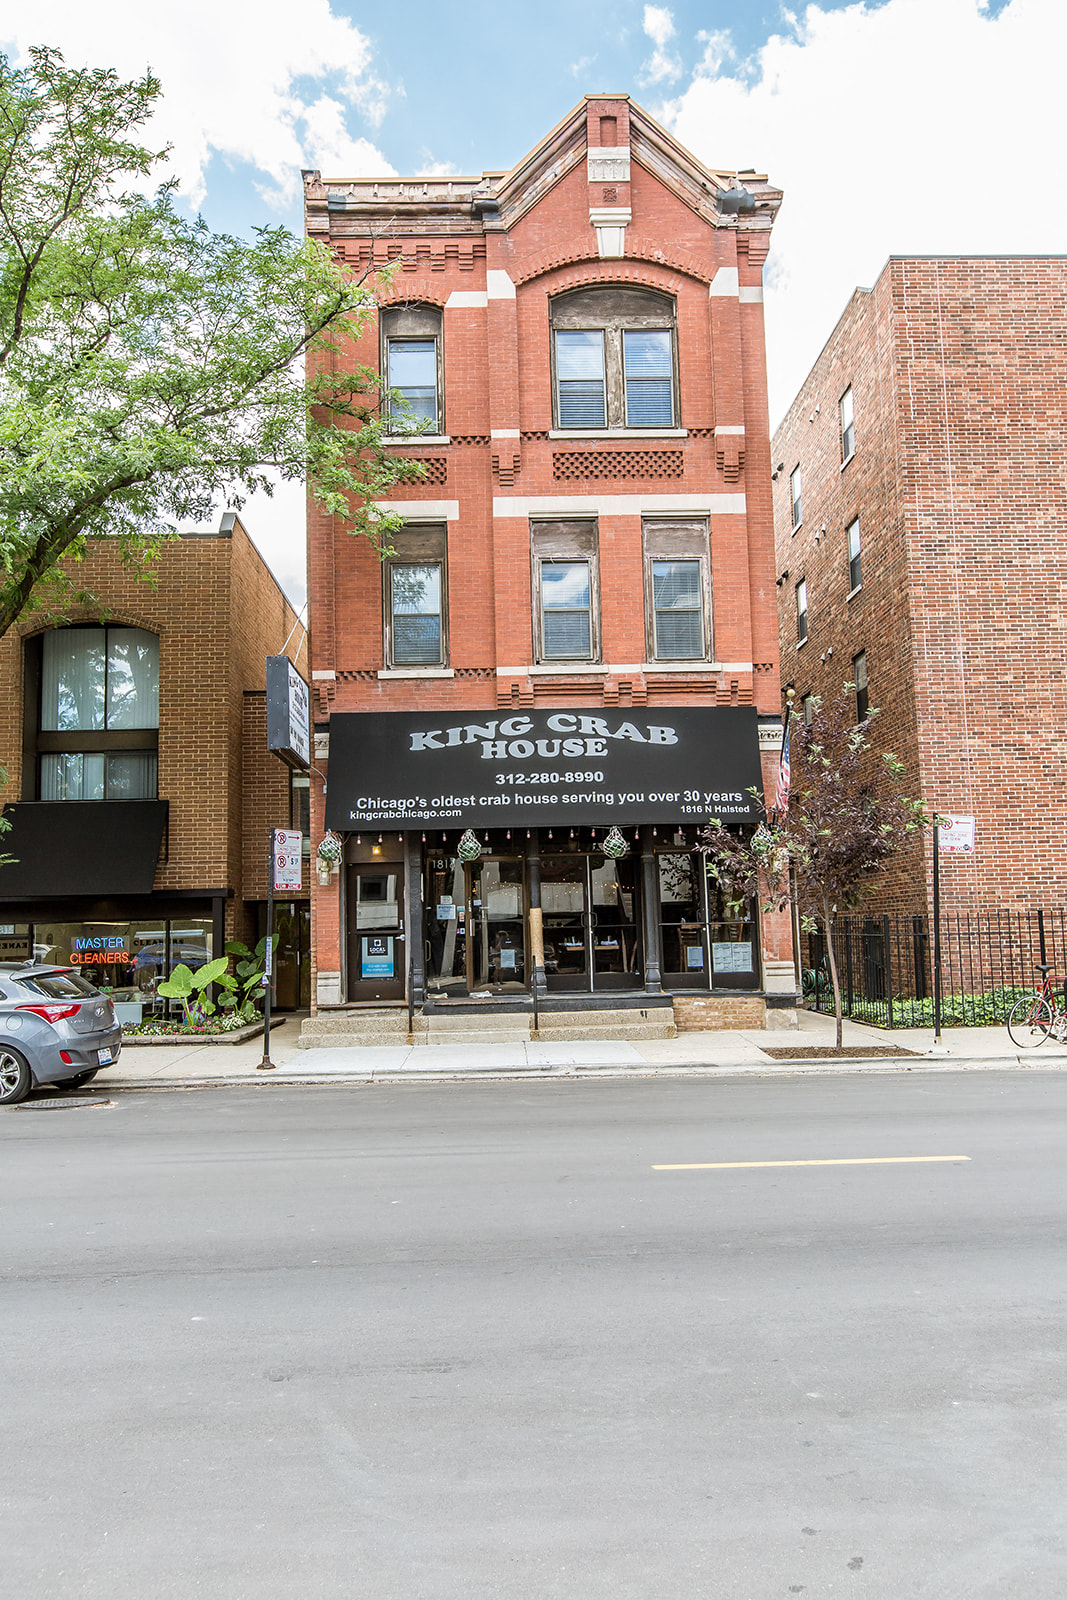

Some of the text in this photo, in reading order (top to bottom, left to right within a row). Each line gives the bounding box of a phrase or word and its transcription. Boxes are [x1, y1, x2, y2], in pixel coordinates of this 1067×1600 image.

[409, 713, 680, 751] KING CRAB
[480, 737, 610, 761] HOUSE
[494, 770, 605, 786] 312-280-8990
[356, 789, 742, 811] Chicago's oldest crab house serving you over 30 years
[349, 807, 462, 822] kingcrabchicago.com
[680, 803, 750, 814] 1816 N Halsted
[75, 936, 125, 950] MASTER
[69, 951, 130, 965] CLEANERS
